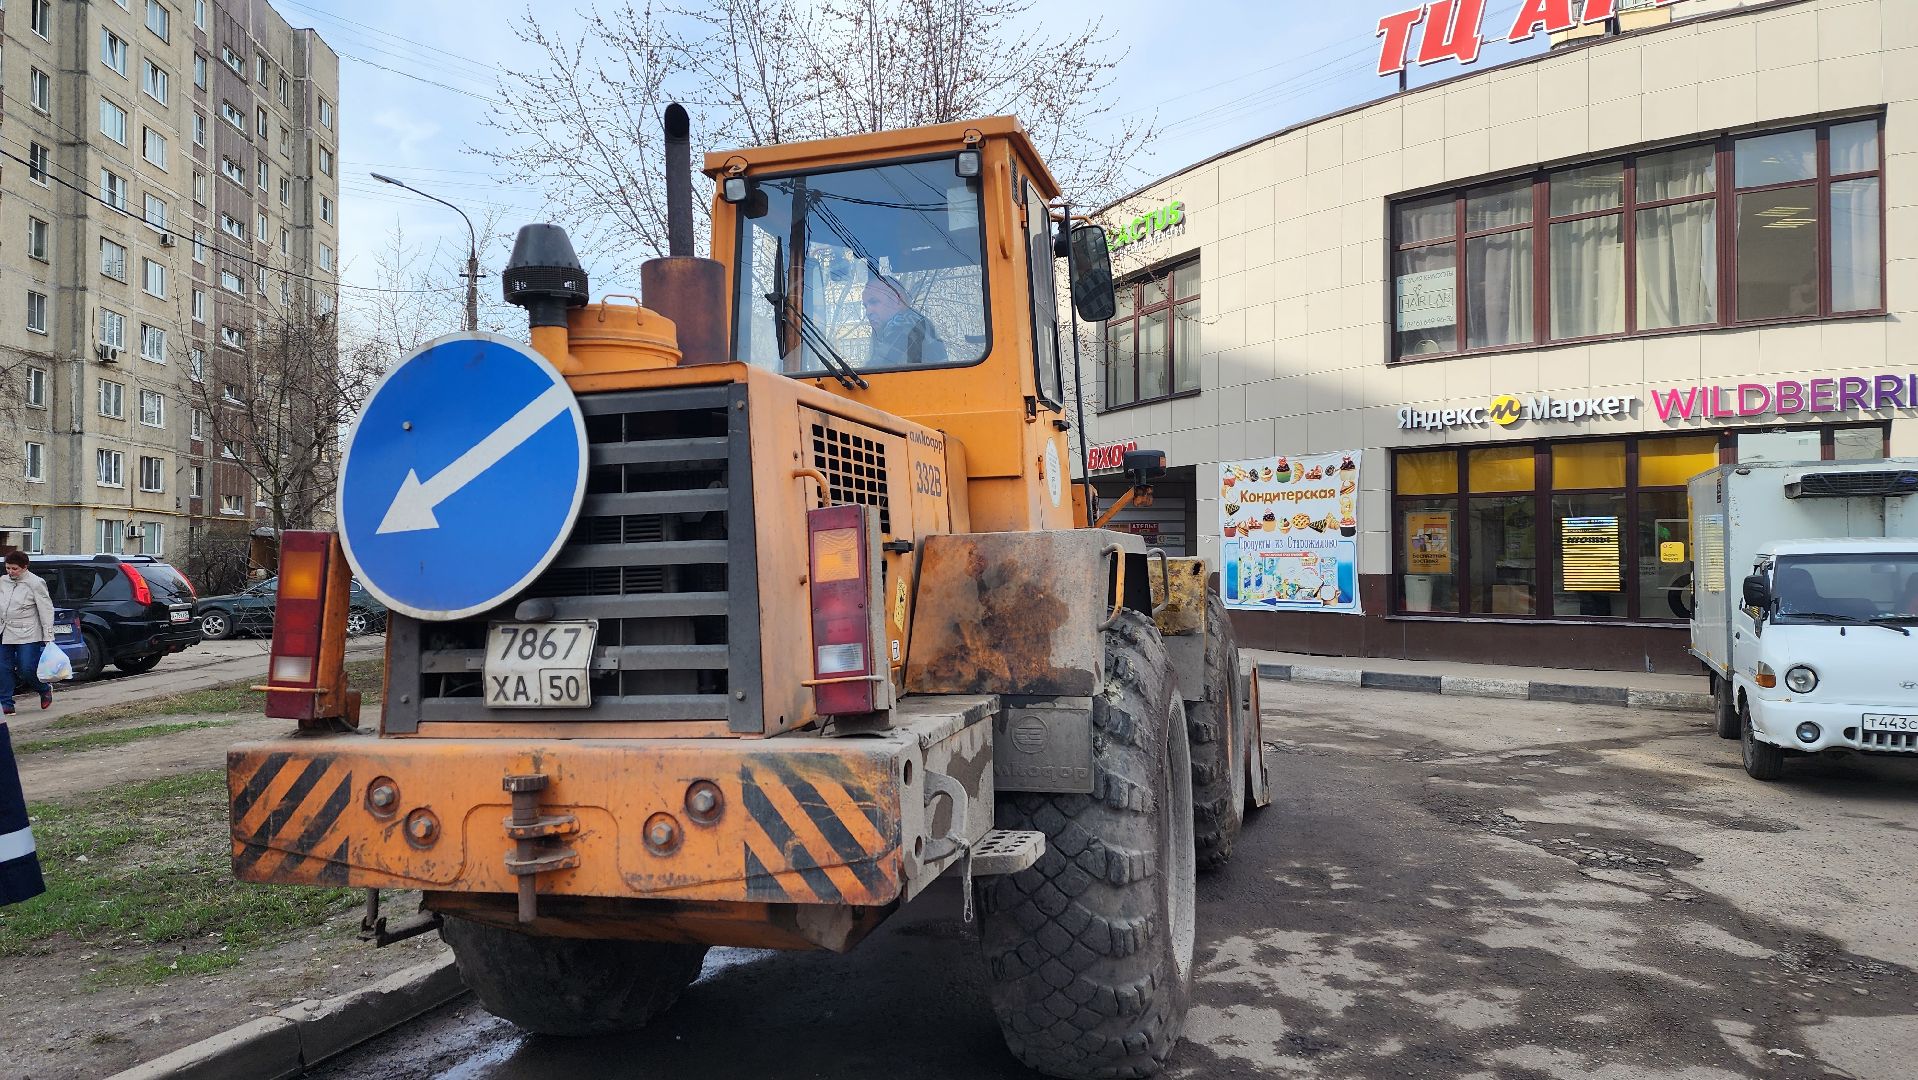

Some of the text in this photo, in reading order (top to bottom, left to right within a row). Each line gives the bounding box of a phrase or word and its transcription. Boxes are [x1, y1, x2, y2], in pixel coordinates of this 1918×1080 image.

[1376, 0, 1487, 75] ТЦ
[1397, 395, 1637, 431] Яндекс Маркет
[1651, 373, 1918, 421] WILDBERRI
[1240, 488, 1336, 504] Кондитерская
[500, 627, 581, 660] 7867
[491, 675, 581, 701] ХА 50
